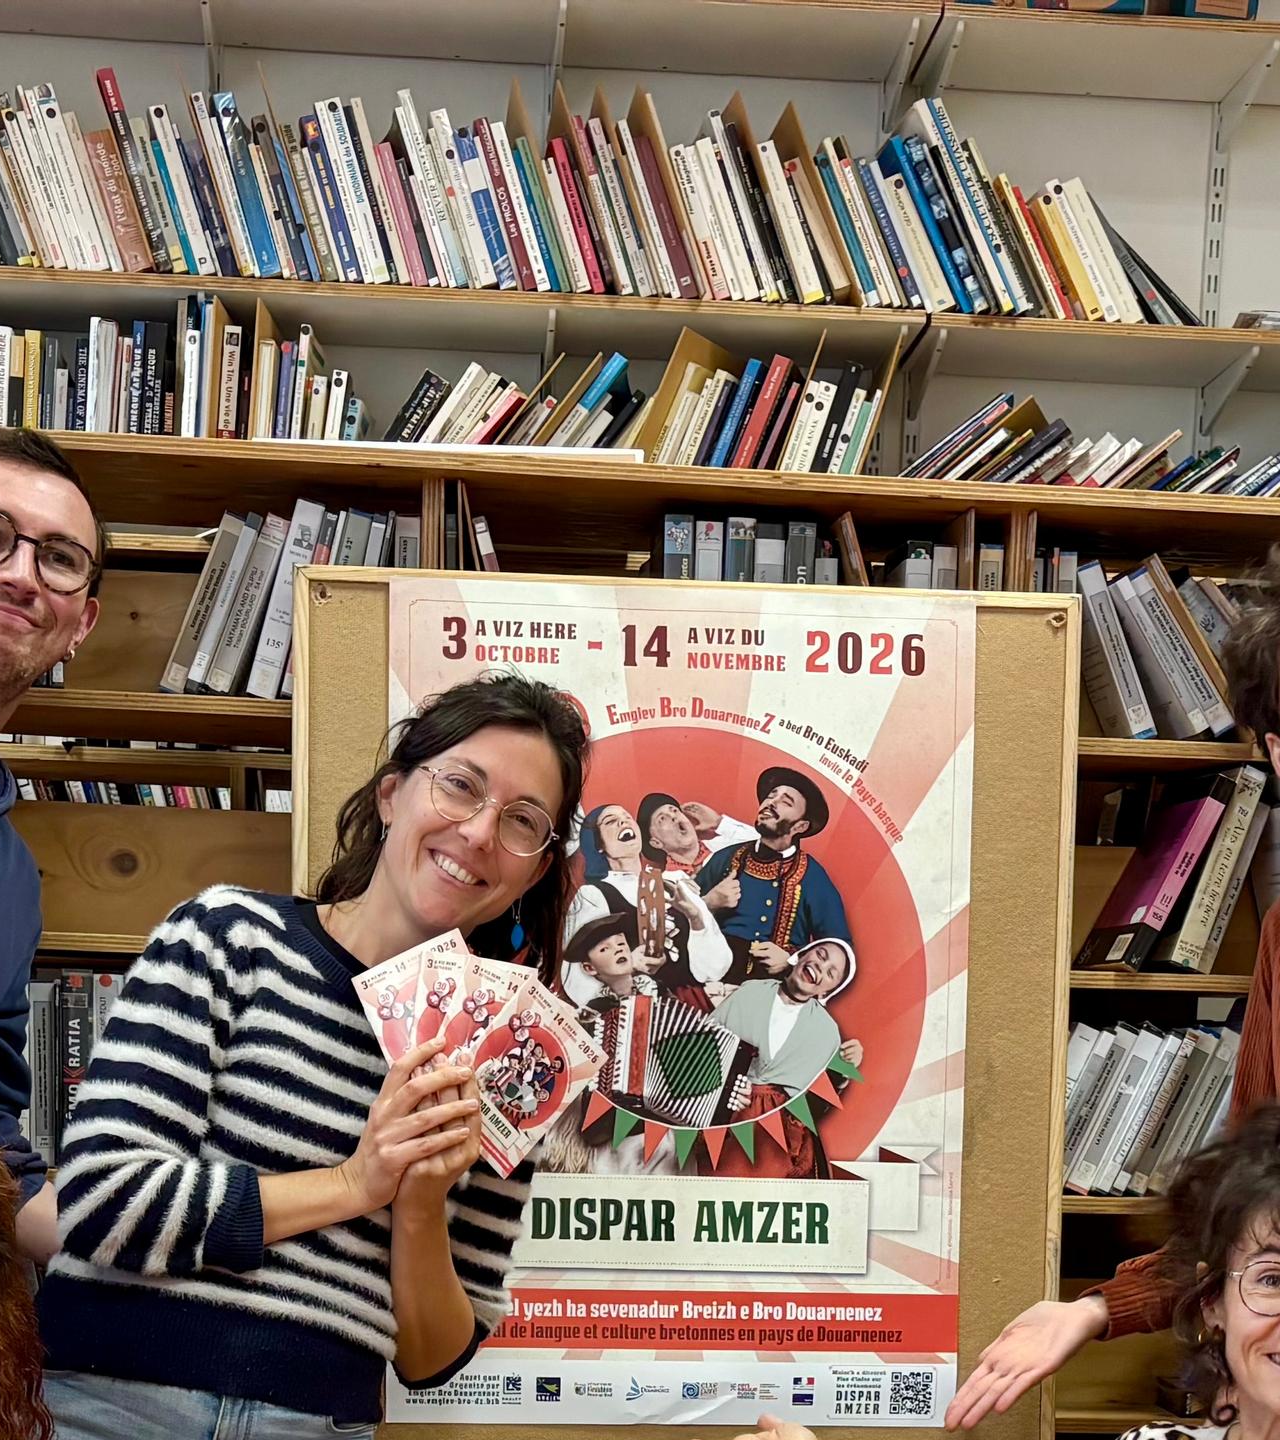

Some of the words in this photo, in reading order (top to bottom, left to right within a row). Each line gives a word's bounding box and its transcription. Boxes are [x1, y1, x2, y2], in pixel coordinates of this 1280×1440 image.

[94, 141, 112, 177] monde
[78, 348, 87, 366] THE
[227, 350, 236, 368] Win
[76, 368, 86, 402] CINEMA
[224, 386, 233, 402] Une
[442, 616, 468, 660] 3
[476, 620, 488, 637] A
[493, 620, 524, 638] VIZ
[530, 622, 577, 640] HERE
[688, 627, 700, 644] A
[705, 627, 736, 646] VIZ
[741, 628, 765, 647] DU
[475, 644, 560, 665] OCTOBRE
[622, 624, 671, 669] 14
[805, 630, 926, 677] 2026
[687, 652, 787, 672] NOVEMBRE
[659, 696, 687, 718] Bro
[802, 725, 825, 747] Bro
[824, 736, 870, 775] Euskadi
[851, 776, 876, 810] Pays
[872, 803, 904, 845] basque
[487, 1112, 512, 1140] AMZER
[530, 1196, 676, 1242] DISPAR
[692, 1199, 831, 1246] AMZER
[523, 1299, 563, 1322] yezh
[566, 1299, 587, 1319] ha
[590, 1300, 678, 1321] sevenadur
[682, 1301, 737, 1321] Breizh
[739, 1306, 750, 1321] e
[752, 1303, 783, 1321] Bro
[786, 1304, 883, 1323] Douarnenez
[510, 1323, 527, 1339] de
[529, 1324, 581, 1342] langue
[584, 1325, 599, 1341] et
[602, 1324, 656, 1342] culture
[659, 1325, 736, 1343] bretonnes
[738, 1329, 756, 1343] en
[758, 1328, 794, 1347] pays
[797, 1326, 815, 1343] de
[817, 1326, 903, 1344] Douarnenez
[835, 1390, 881, 1401] DISPAR
[835, 1403, 880, 1415] AMZER
